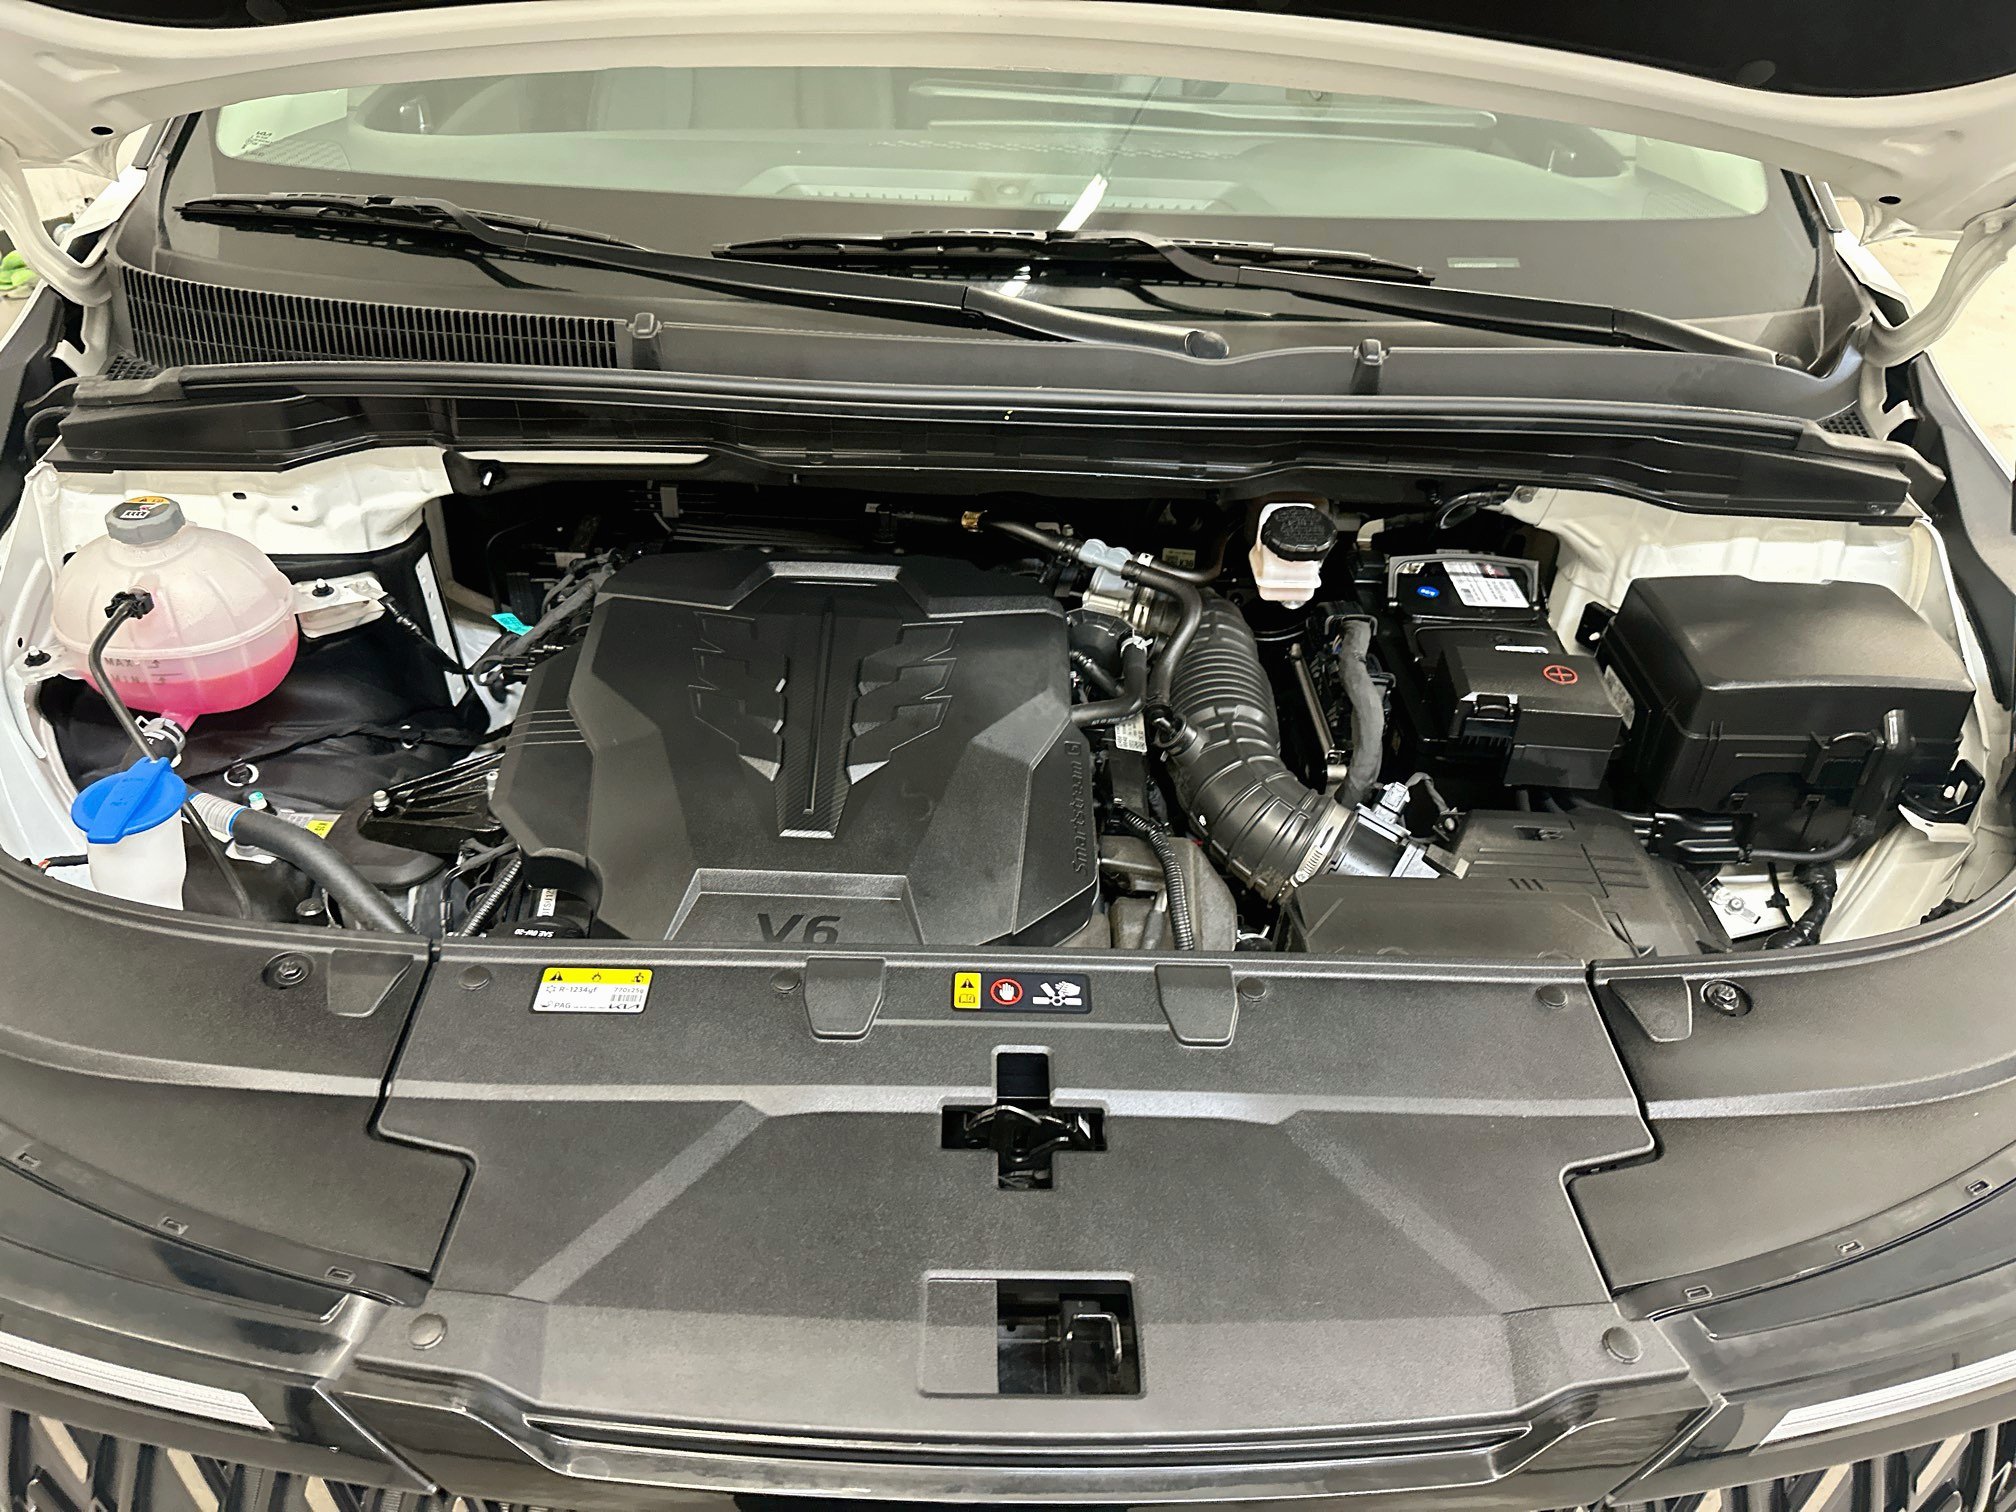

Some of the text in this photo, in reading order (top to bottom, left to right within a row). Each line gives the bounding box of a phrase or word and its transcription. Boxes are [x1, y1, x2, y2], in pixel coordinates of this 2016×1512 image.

[104, 657, 133, 667] MAX
[757, 913, 841, 944] V6
[538, 930, 555, 938] SAE
[558, 986, 598, 994] R-1234yf
